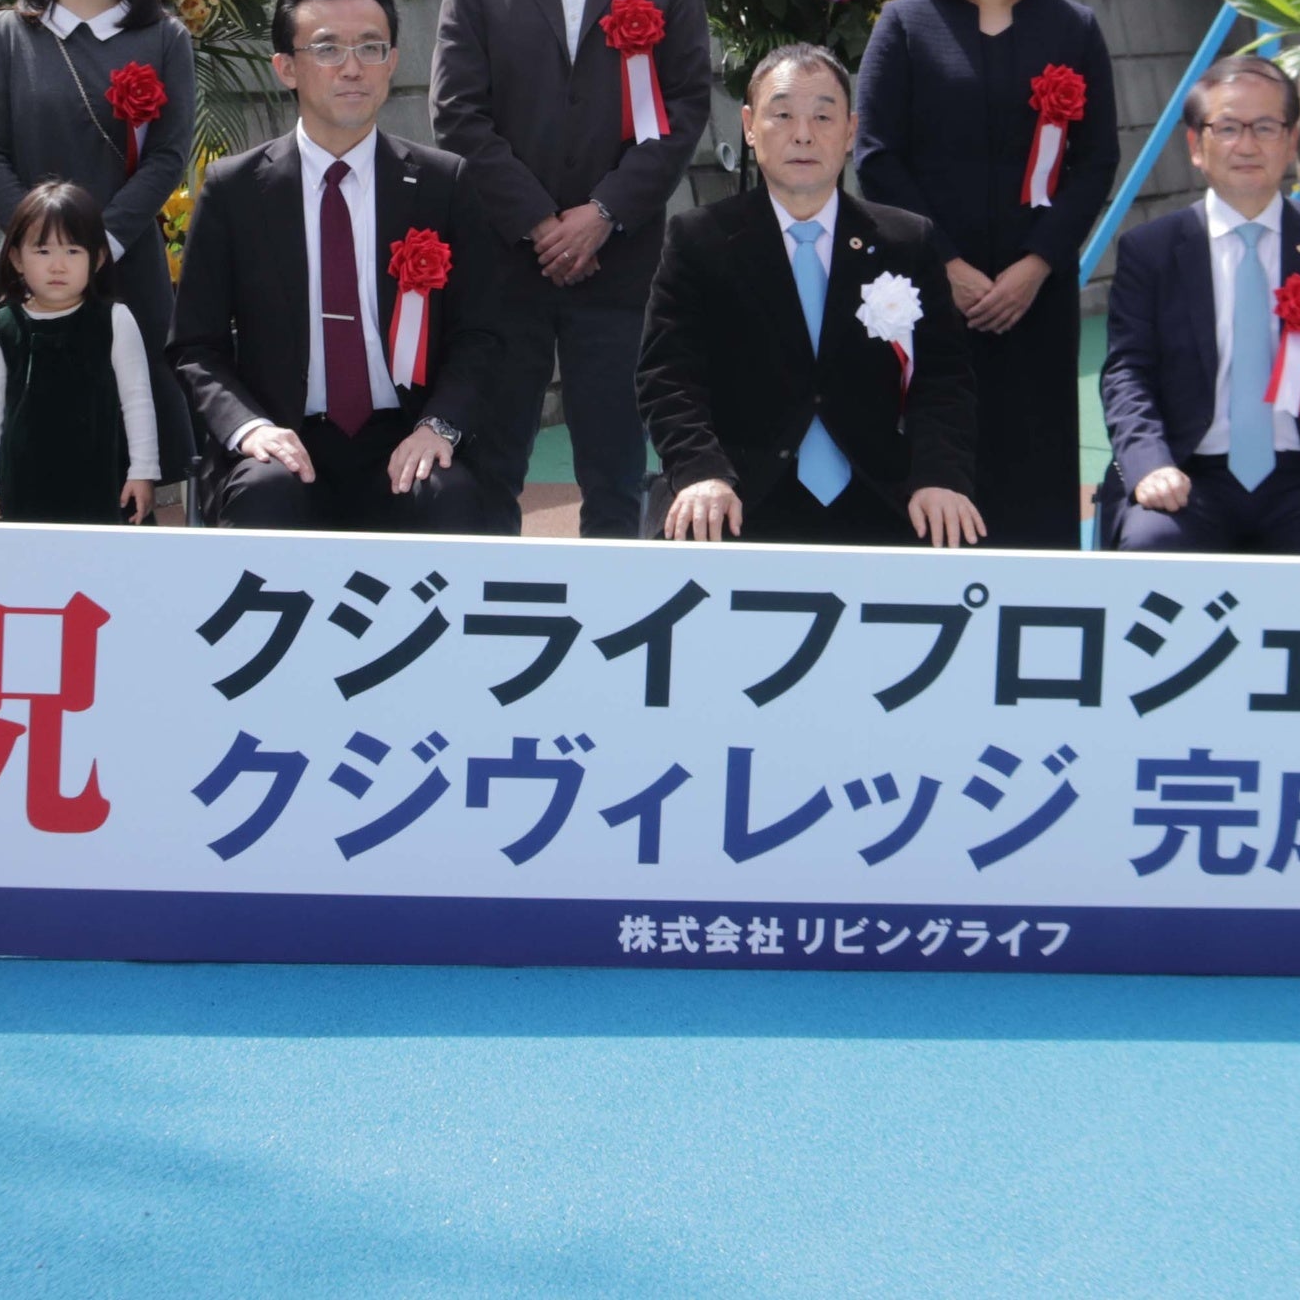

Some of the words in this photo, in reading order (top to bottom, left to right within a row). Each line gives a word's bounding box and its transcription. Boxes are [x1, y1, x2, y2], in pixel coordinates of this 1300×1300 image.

[190, 730, 1079, 872] クジヴィレッジ
[618, 915, 1071, 956] 株式会社リビングライフ
